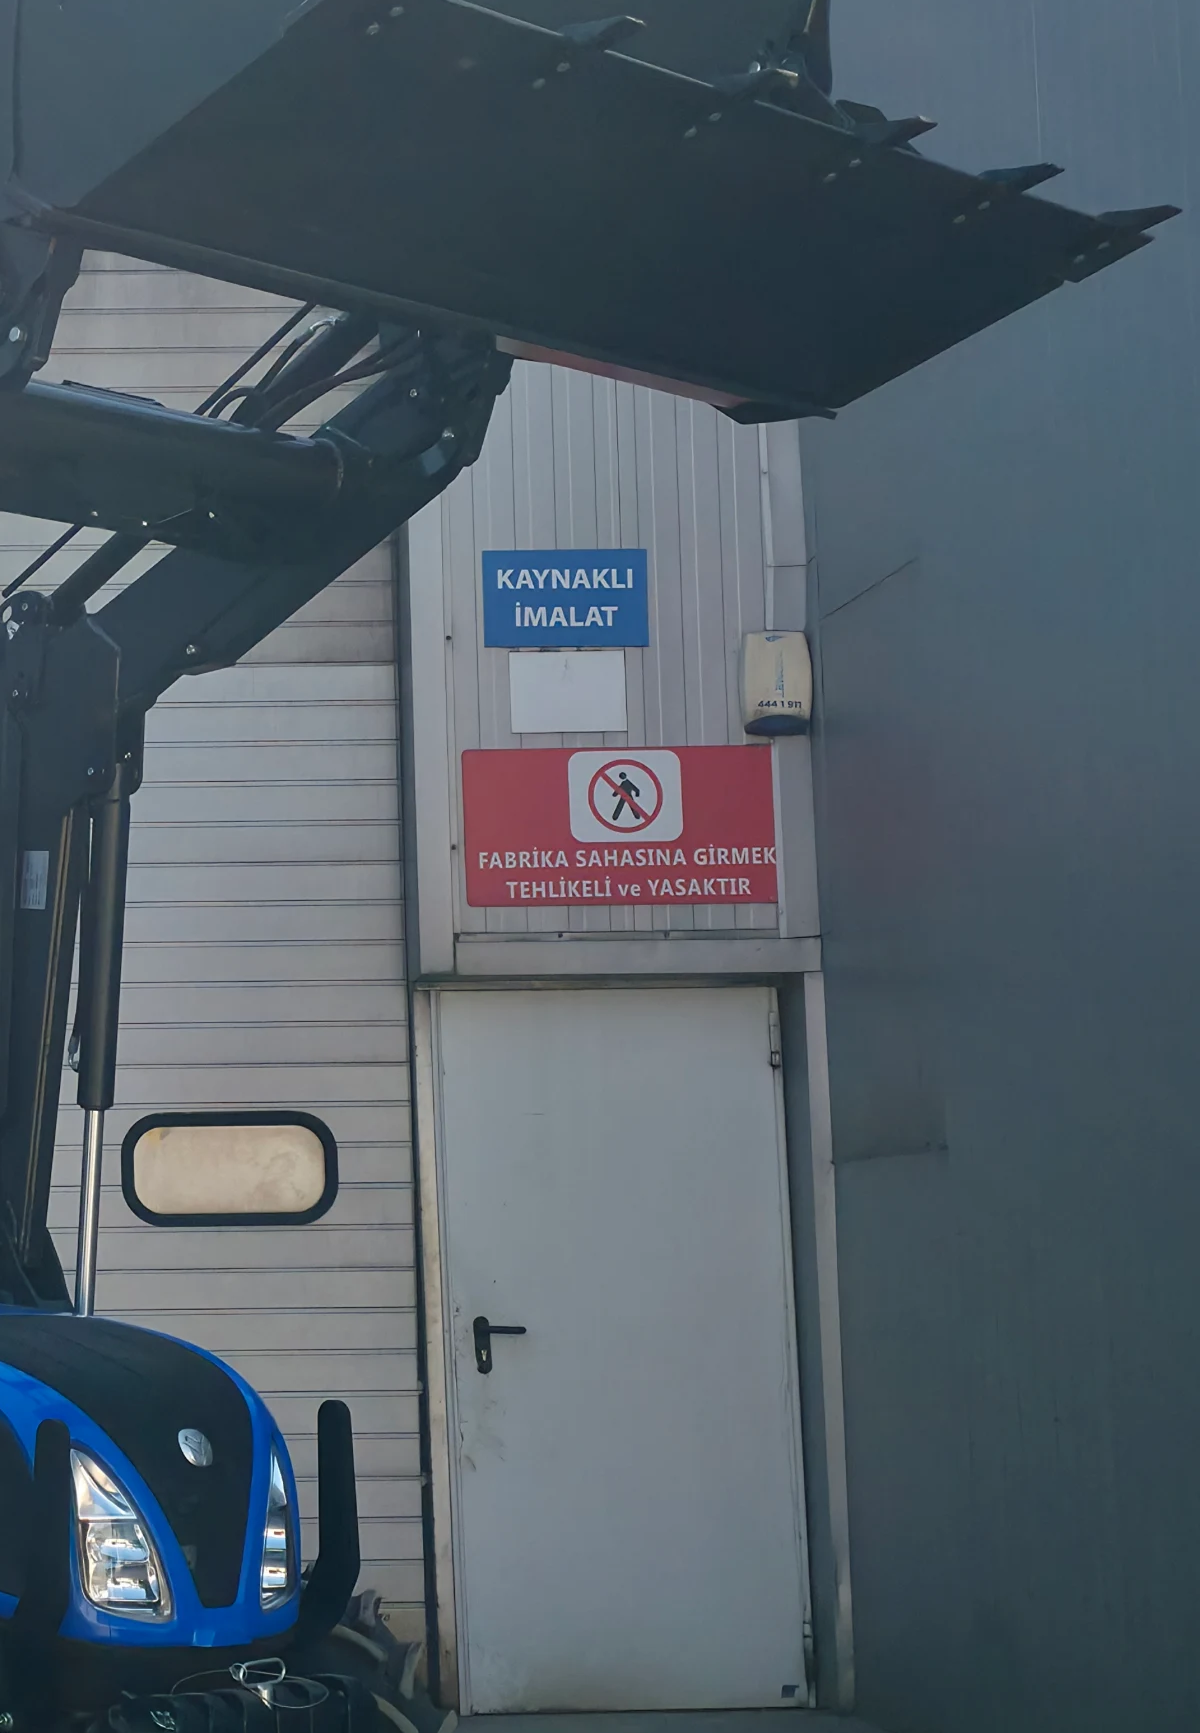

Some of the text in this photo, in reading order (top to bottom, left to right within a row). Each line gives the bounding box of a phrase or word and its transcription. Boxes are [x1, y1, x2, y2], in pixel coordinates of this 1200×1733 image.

[497, 568, 634, 590] KAYNAKLI
[515, 602, 619, 627] İMALAT
[478, 844, 776, 870] FABRİKA SAHASINA GİRMEK
[506, 875, 751, 900] TEHLİKELİ ve YASAKTIR
